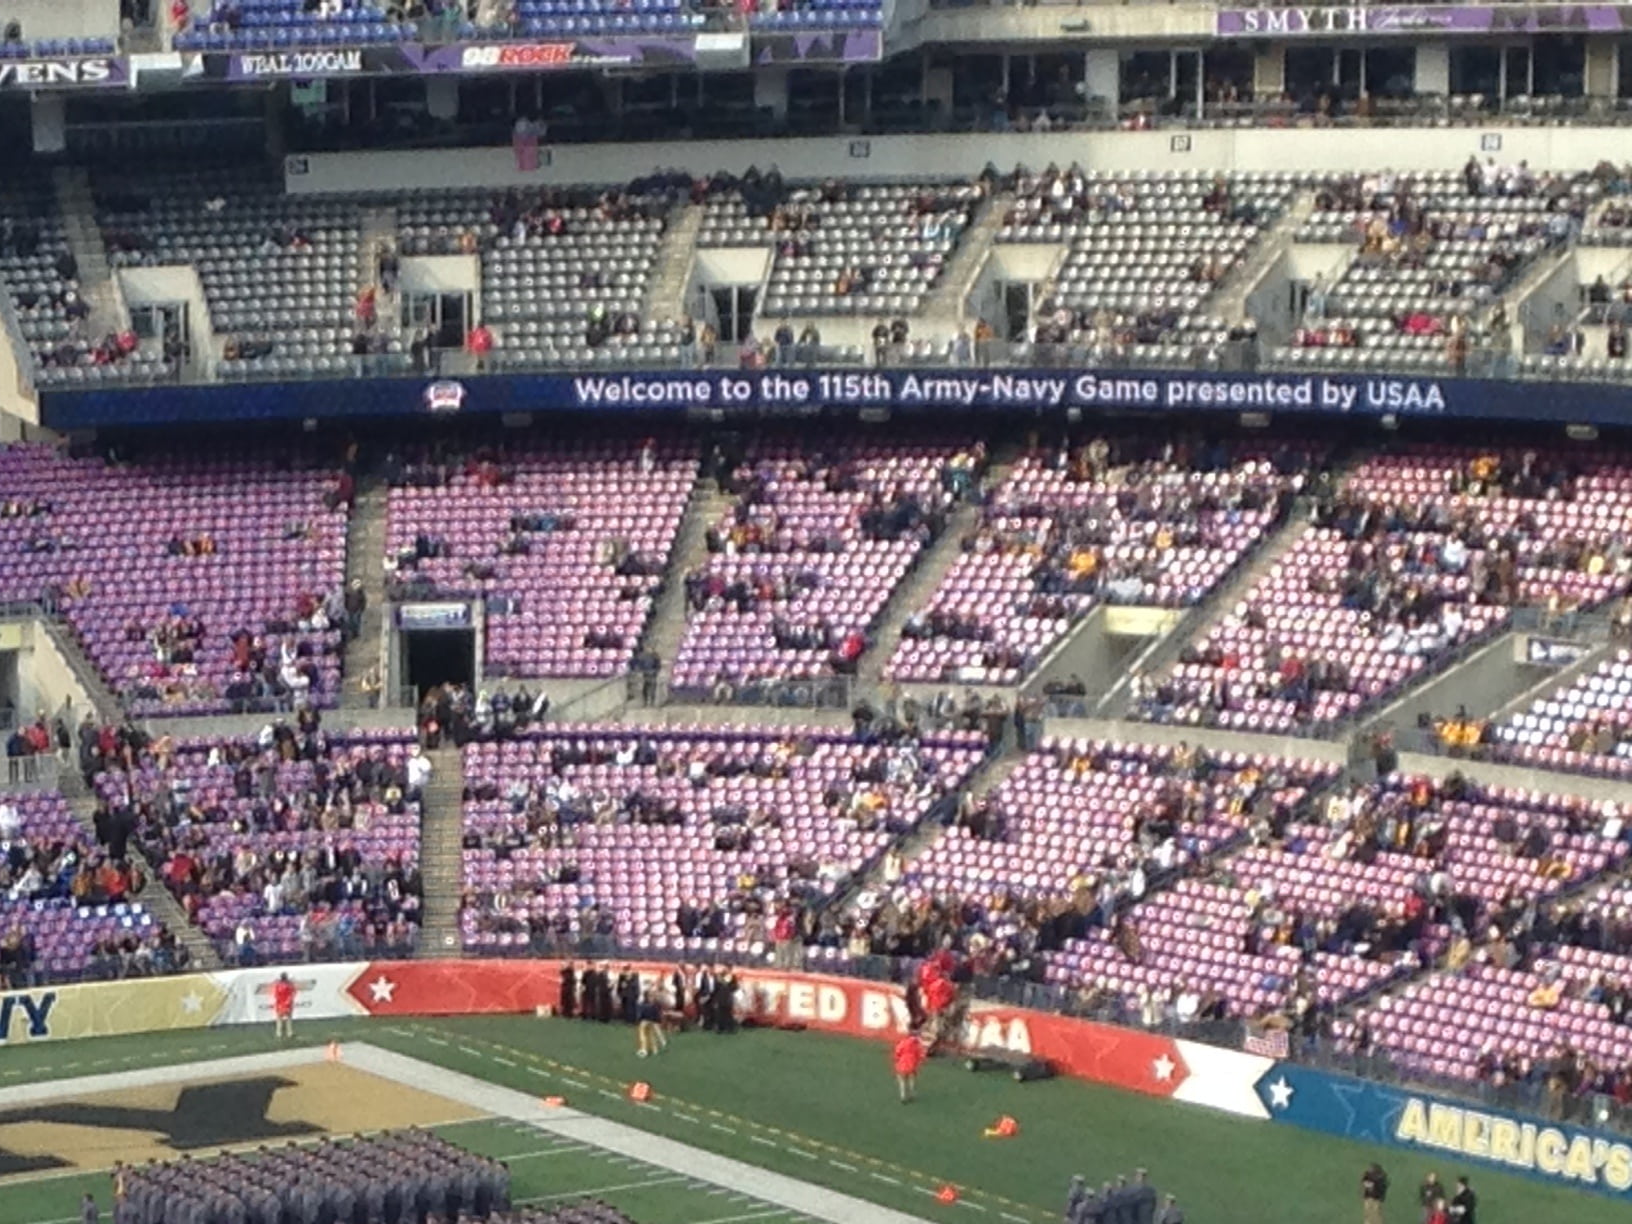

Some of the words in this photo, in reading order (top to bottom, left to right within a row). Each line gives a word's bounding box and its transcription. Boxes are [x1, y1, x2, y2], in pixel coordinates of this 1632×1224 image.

[1244, 8, 1367, 32] SMYTH
[574, 376, 711, 401] Welcome
[721, 377, 752, 400] to
[762, 376, 810, 399] the
[819, 375, 891, 400] 115th
[901, 375, 1065, 404] Army-Navy
[1076, 375, 1158, 400] Game
[1169, 379, 1312, 406] presented
[1323, 379, 1357, 411] by
[1369, 382, 1446, 410] USAA
[1394, 1097, 1632, 1191] AMERICA'S
